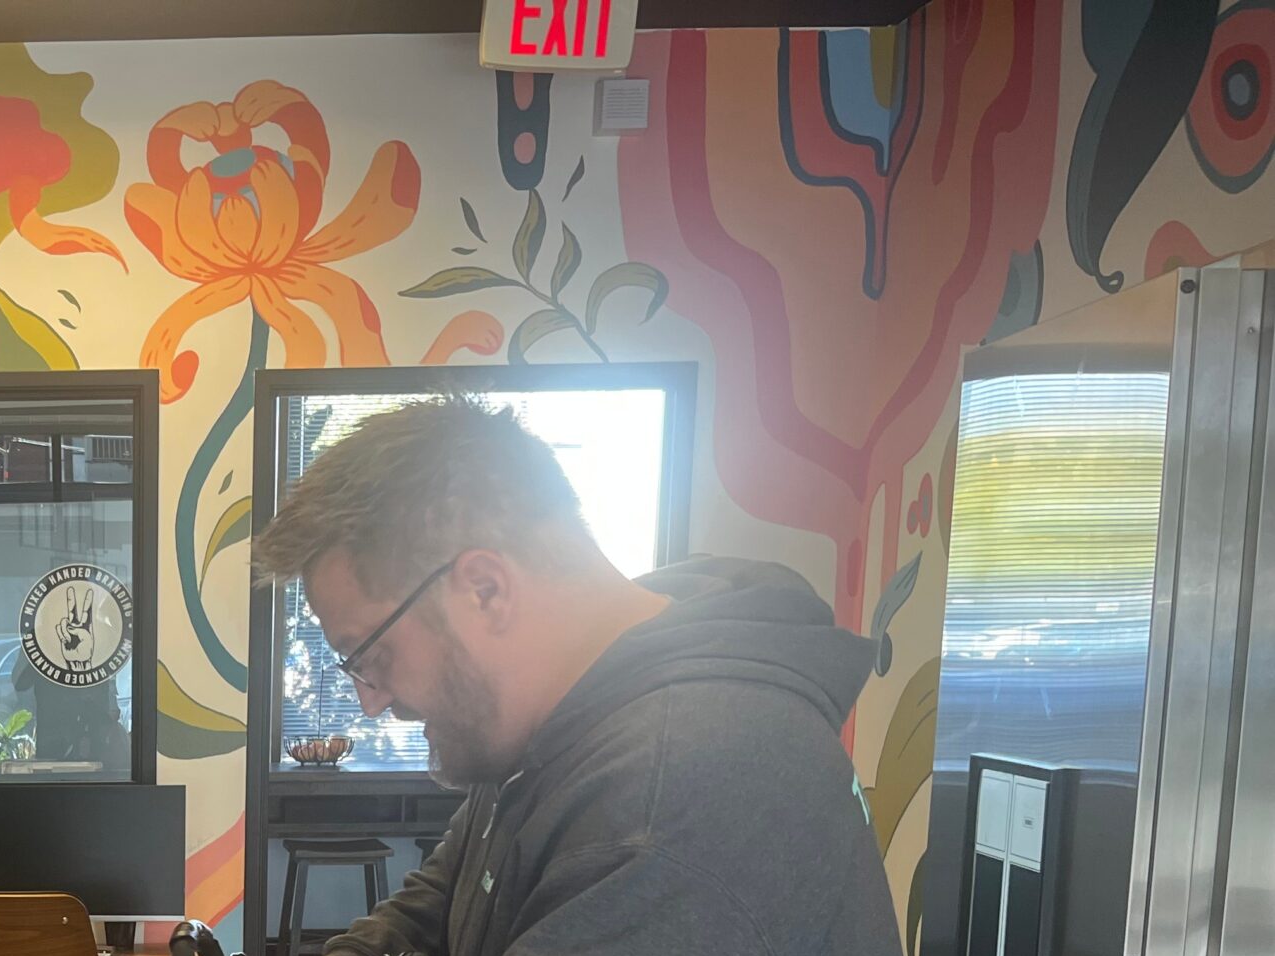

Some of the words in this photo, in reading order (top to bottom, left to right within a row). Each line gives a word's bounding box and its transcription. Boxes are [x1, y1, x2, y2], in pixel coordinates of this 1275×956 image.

[24, 584, 47, 616] MIXED
[49, 567, 91, 585] HANDED
[23, 633, 61, 679] BRANDING
[64, 670, 107, 684] HANDED
